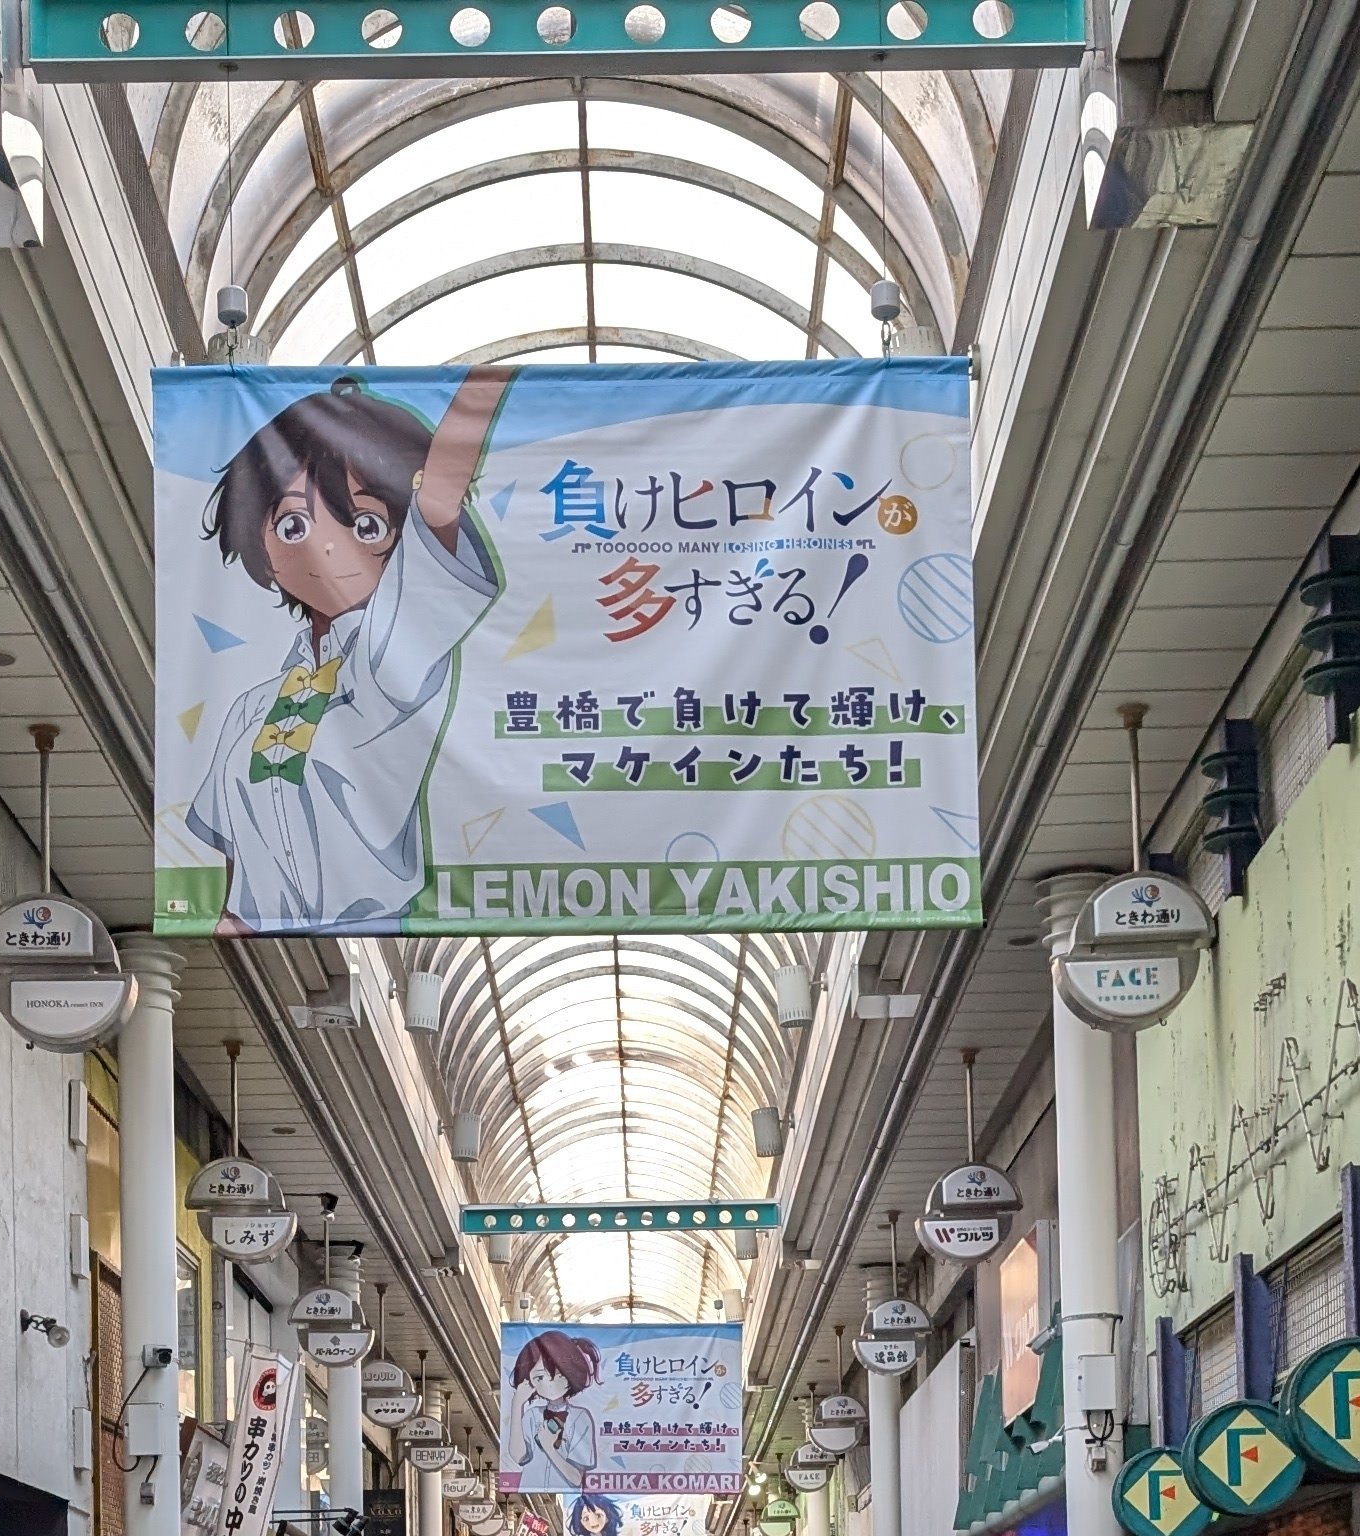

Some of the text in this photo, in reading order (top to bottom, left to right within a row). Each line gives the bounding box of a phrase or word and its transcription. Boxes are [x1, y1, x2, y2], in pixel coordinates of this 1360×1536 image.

[540, 459, 918, 541] 負けヒロインが
[678, 541, 720, 552] MANY
[726, 539, 778, 551] LOSING
[783, 538, 852, 550] HEROINES
[596, 553, 869, 645] 多すぎる!
[505, 686, 959, 733] 豊橋で負けて輝け、
[438, 862, 971, 921] LEMON YAKISHIO
[1115, 909, 1181, 926] ときわ通り
[5, 931, 72, 947] ときわ通り
[1097, 967, 1159, 988] FACE
[26, 1000, 69, 1008] HONOKA
[209, 1183, 254, 1194] ときわ通り
[957, 1186, 1000, 1198] ときわ通り
[224, 1229, 275, 1247] しみず
[957, 1231, 994, 1242] ワルツ
[305, 1306, 341, 1315] ときわ通り
[884, 1316, 917, 1325] ときわ通り
[830, 1408, 857, 1416] ときわ通り
[585, 1472, 740, 1491] CHIKA KOMARI
